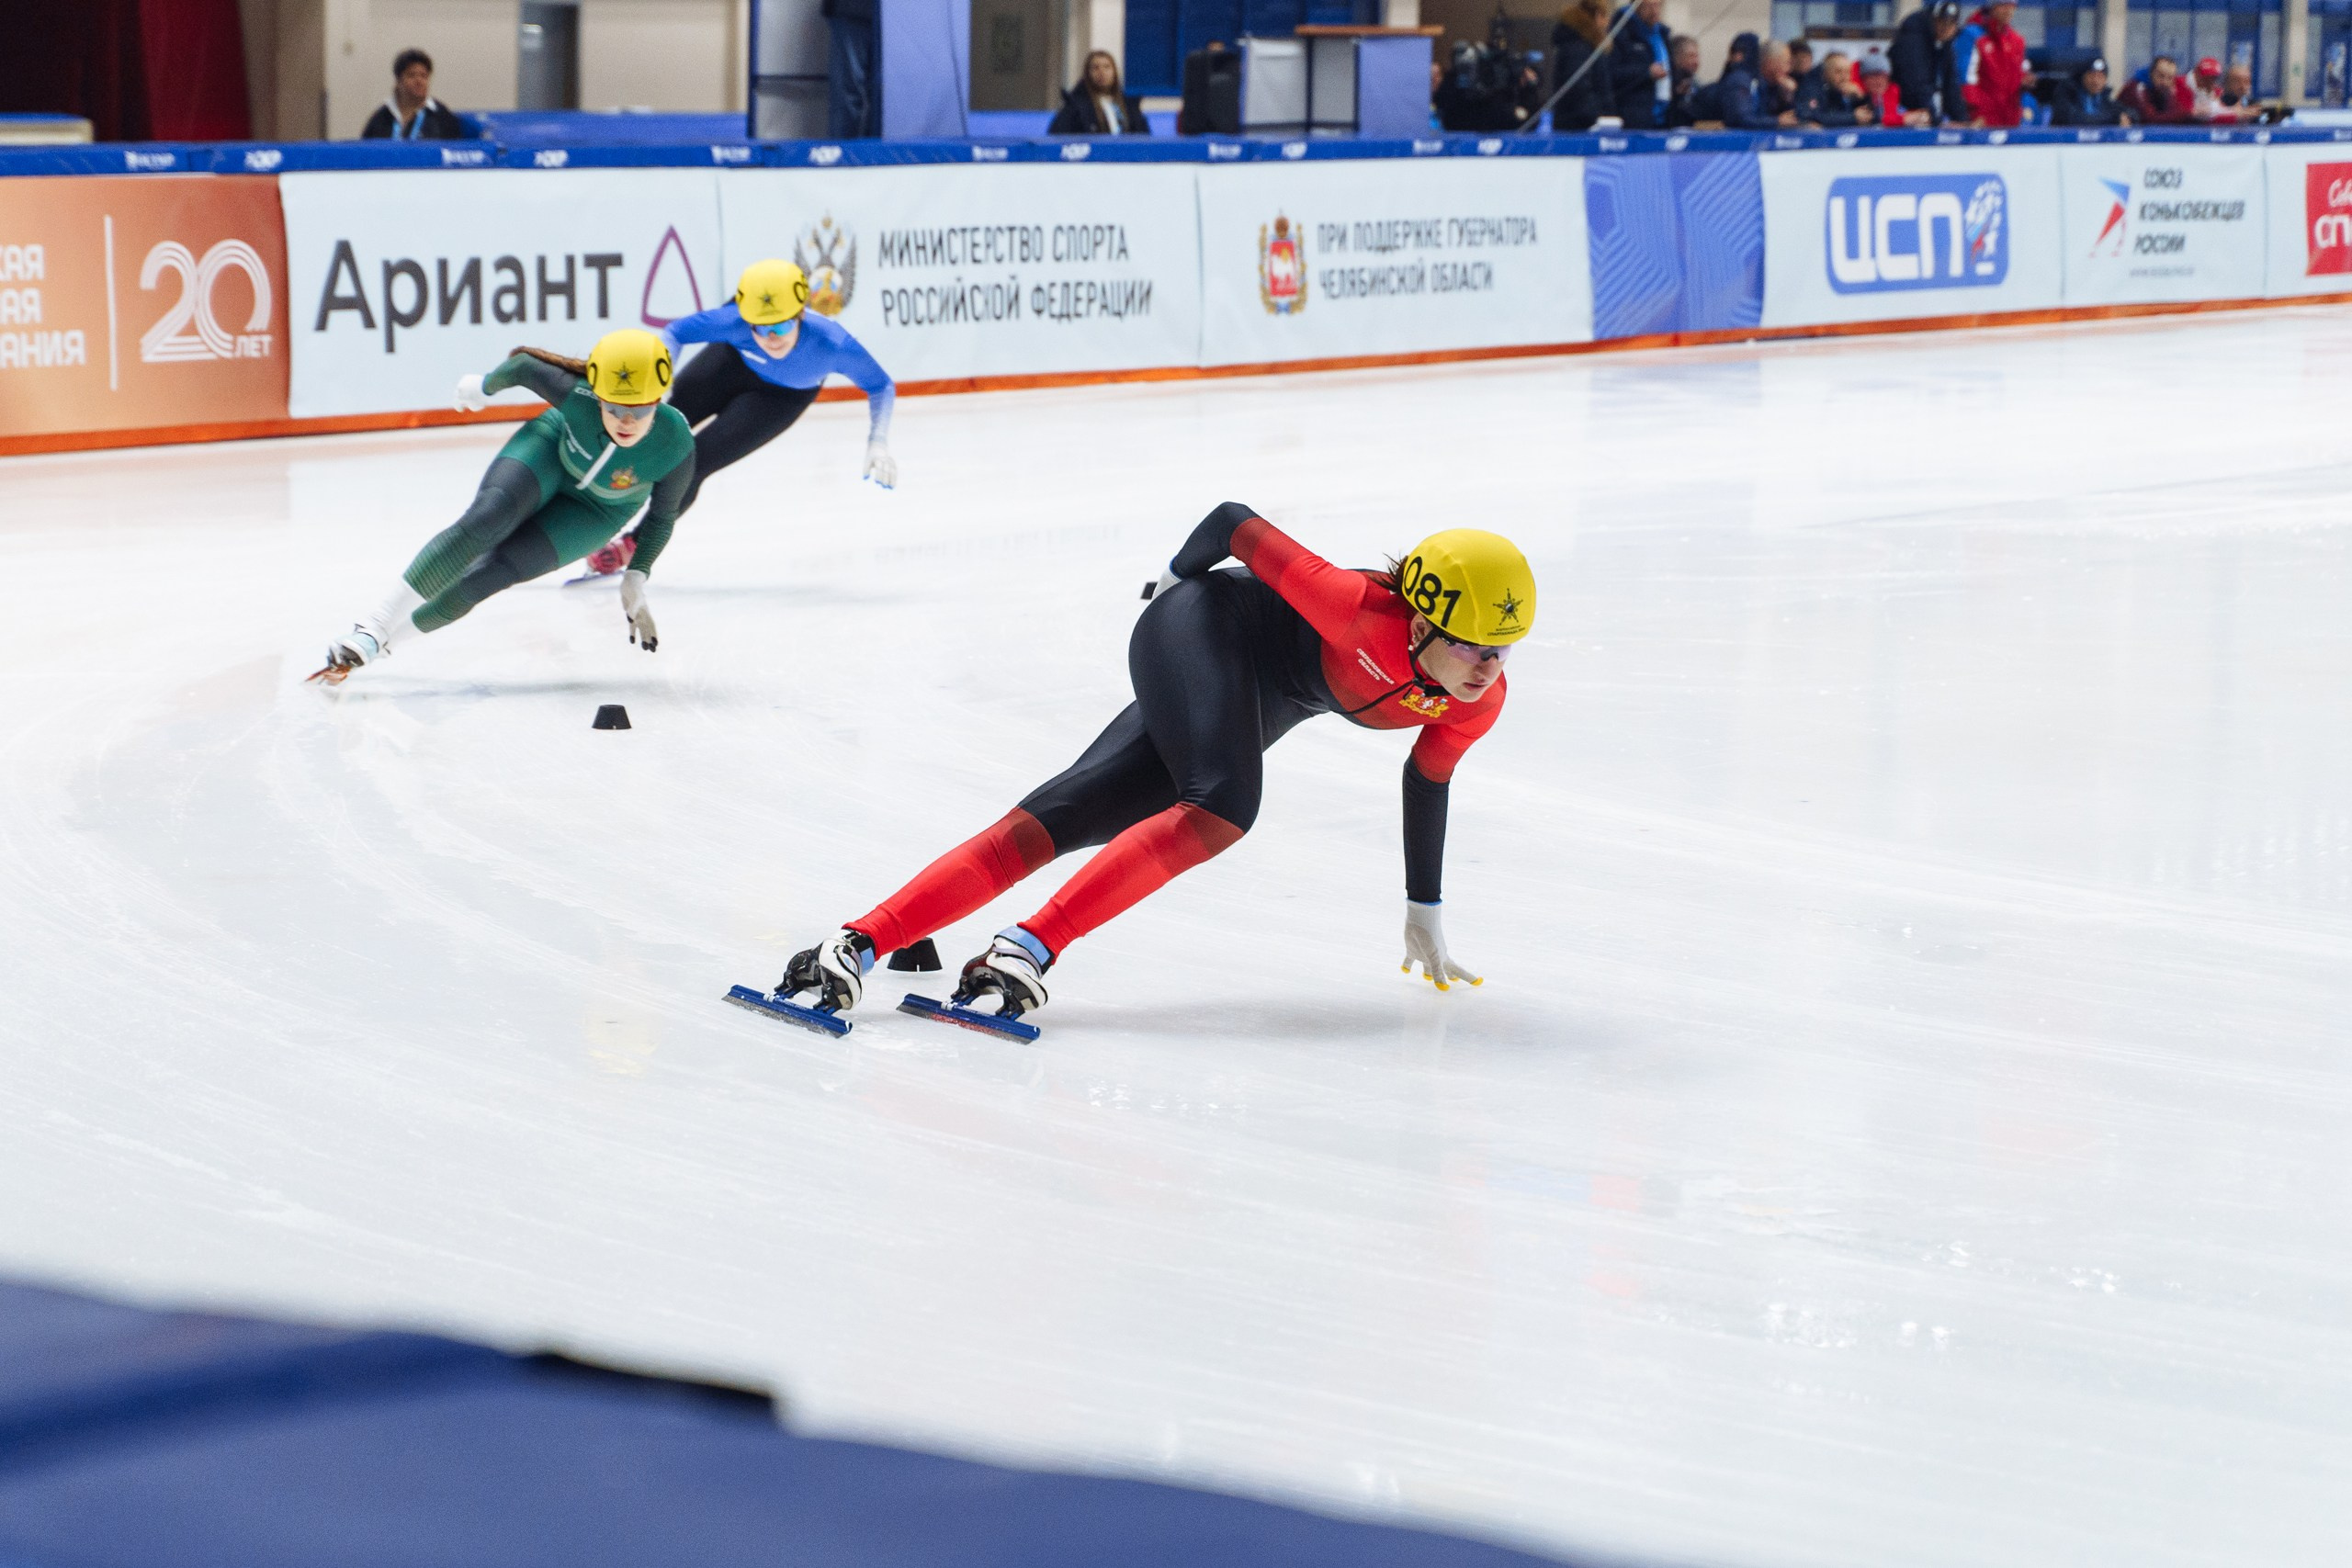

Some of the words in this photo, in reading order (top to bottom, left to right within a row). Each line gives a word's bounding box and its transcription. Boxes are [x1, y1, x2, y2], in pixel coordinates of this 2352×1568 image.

[2144, 168, 2184, 190] СОЮЗ
[878, 226, 1044, 267] МИНИСТЕРСТВО
[1053, 225, 1130, 263] СПОРТА
[1318, 223, 1349, 253] ПРИ
[1354, 219, 1443, 254] ПОДДЕРЖКЕ
[1448, 216, 1538, 248] ГУБЕРНАТОРА
[2134, 234, 2187, 256] РОССИИ
[314, 240, 624, 354] Ариант
[1320, 259, 1427, 300] ЧЕЛЯБИНСКОЙ
[1432, 263, 1494, 293] ОБЛАСТИ
[140, 239, 273, 364] 20
[235, 335, 273, 358] ЛЕТ
[882, 276, 1021, 327] РОССИЙСКОЙ
[1032, 281, 1153, 322] ФЕДЕРАЦИИ
[1403, 556, 1462, 629] 081
